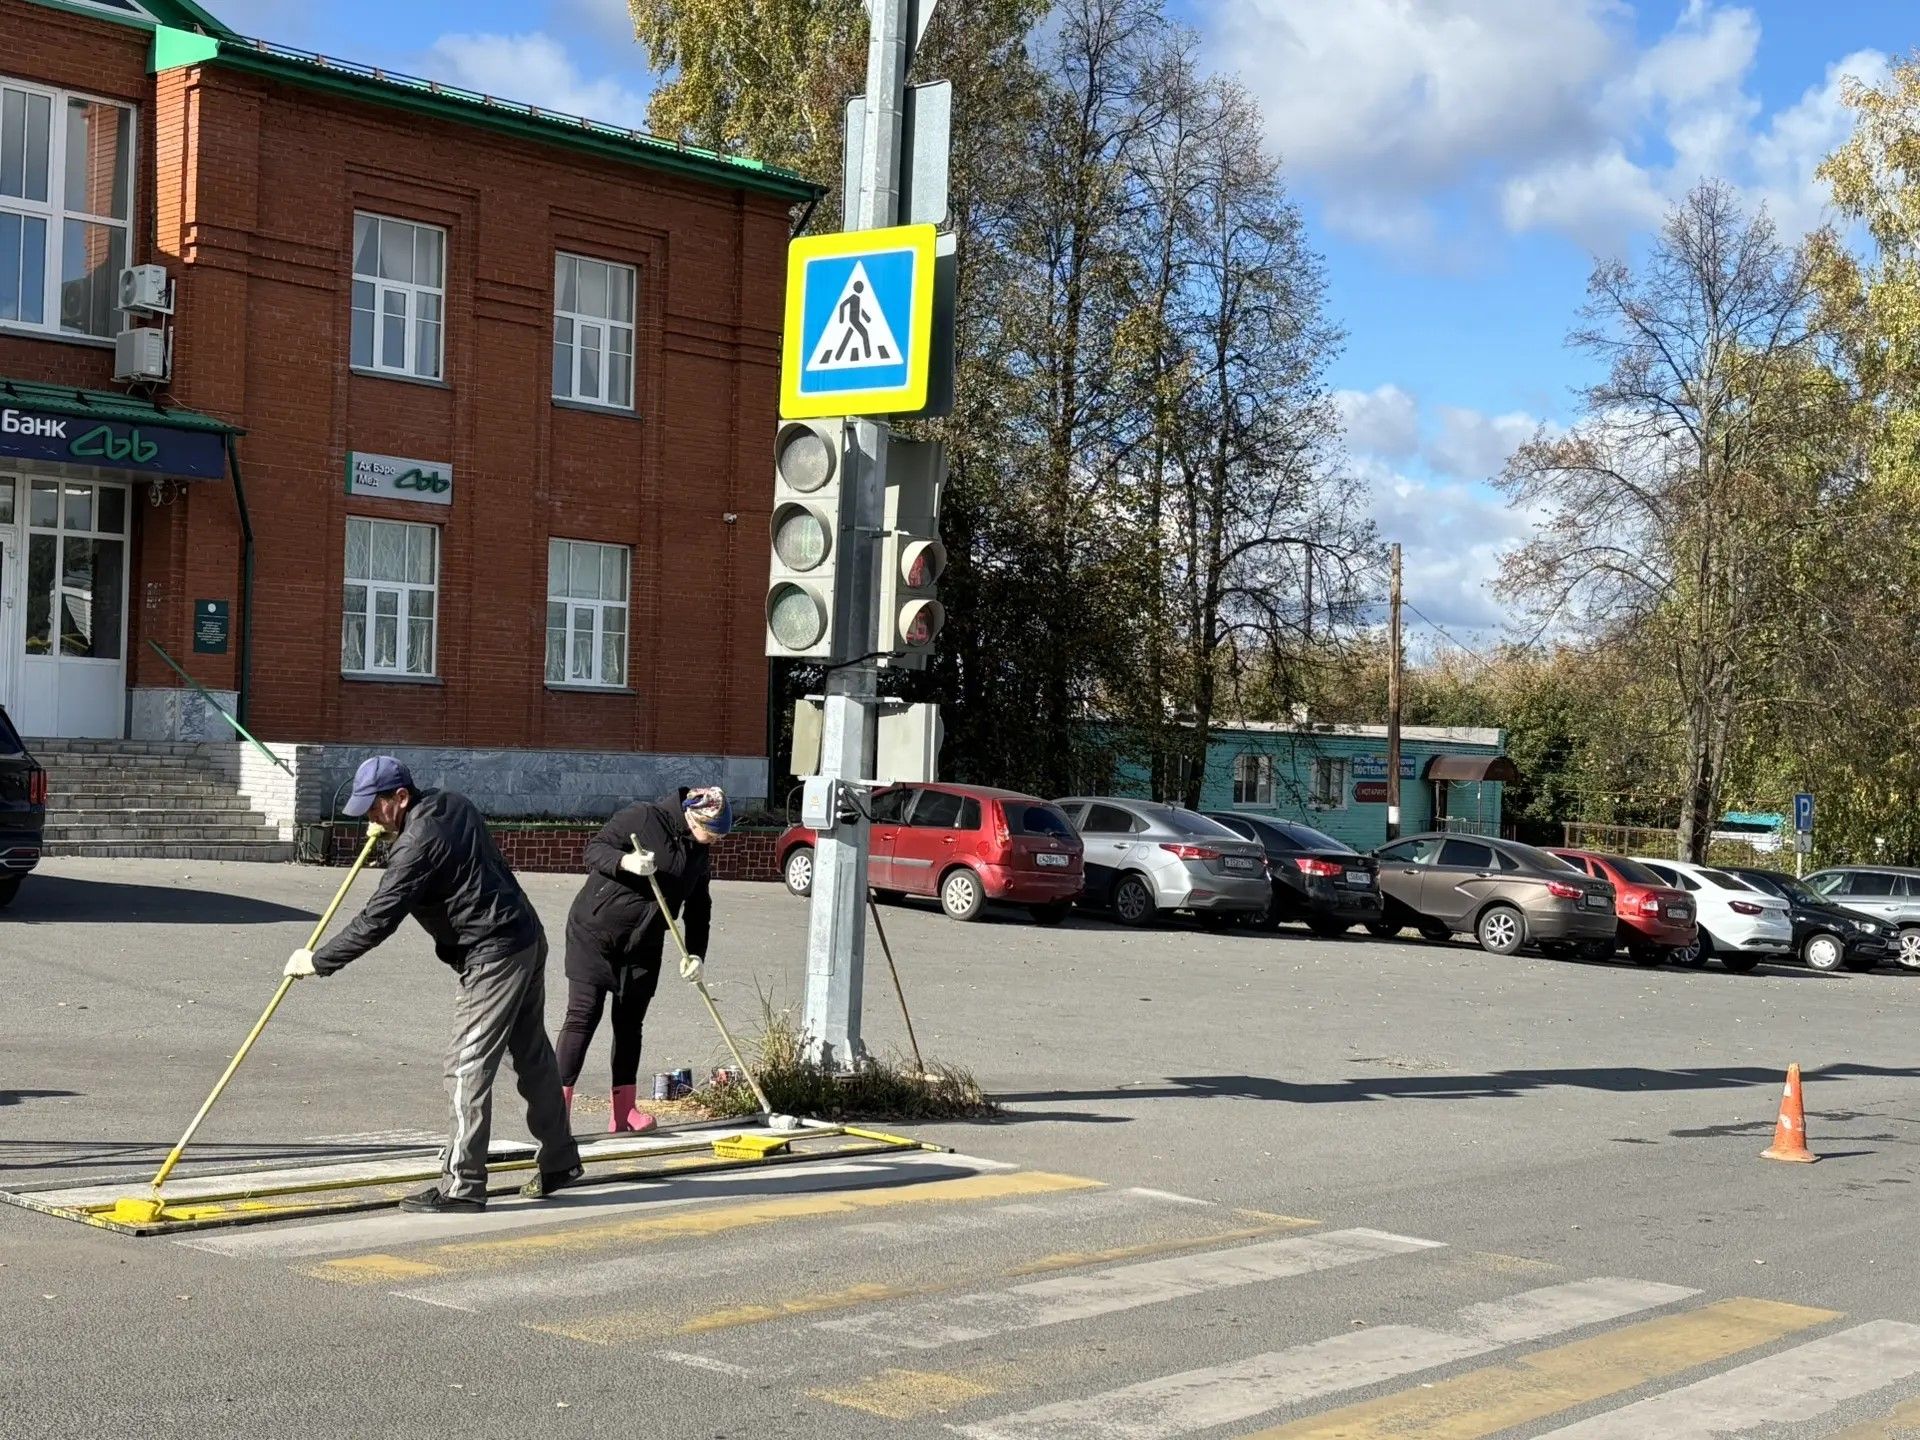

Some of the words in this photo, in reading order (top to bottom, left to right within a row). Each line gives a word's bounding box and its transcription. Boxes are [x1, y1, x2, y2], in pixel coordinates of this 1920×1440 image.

[2, 409, 67, 439] Банк
[358, 461, 372, 472] Ак
[358, 474, 379, 487] Мед
[1800, 798, 1810, 828] P
